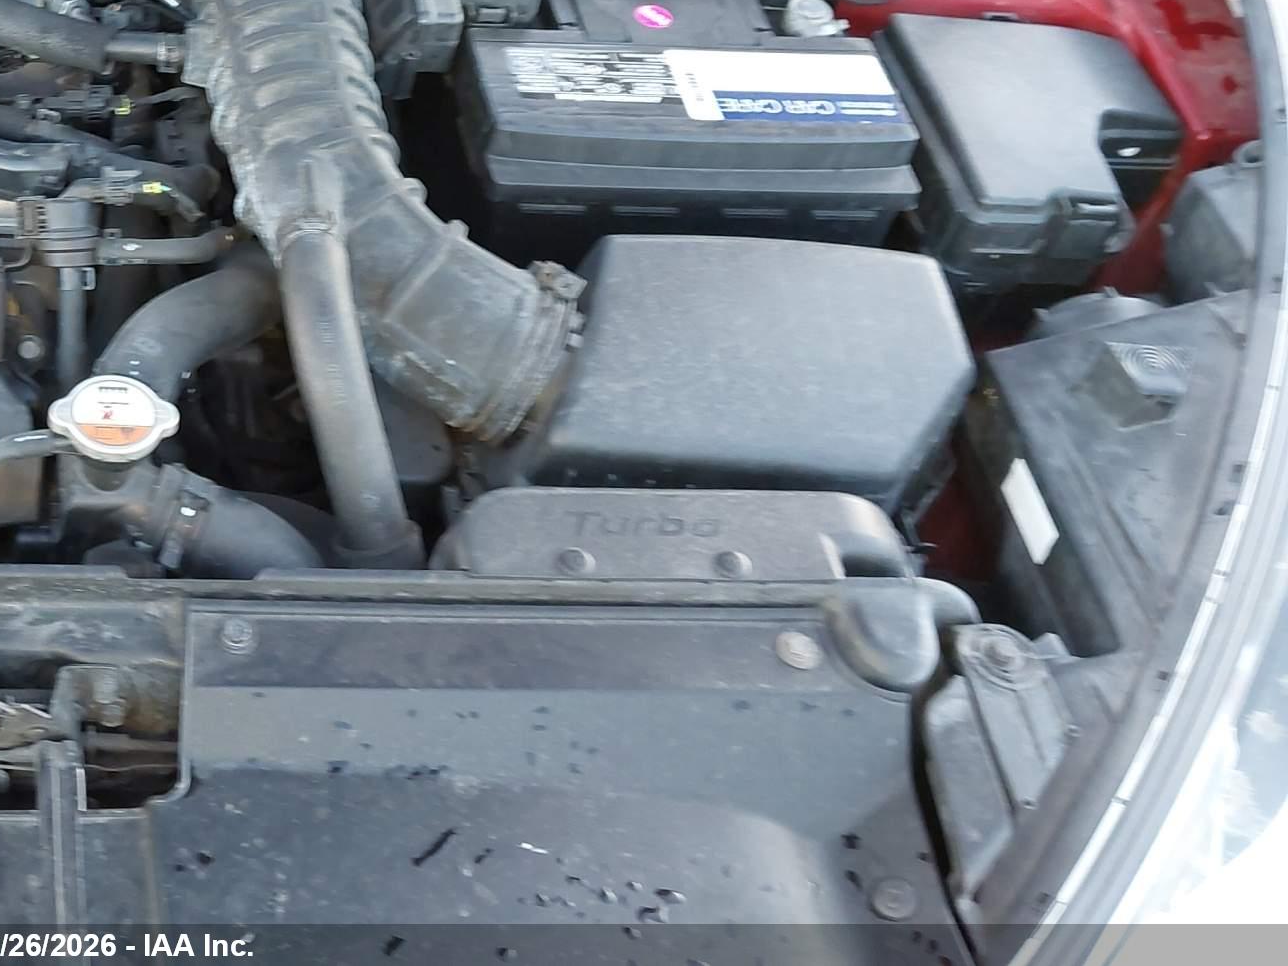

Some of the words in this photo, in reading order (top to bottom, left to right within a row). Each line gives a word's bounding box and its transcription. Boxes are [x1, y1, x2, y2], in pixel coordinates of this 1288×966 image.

[716, 97, 783, 114] CARE
[783, 99, 837, 116] CAR
[564, 510, 720, 536] Turbo
